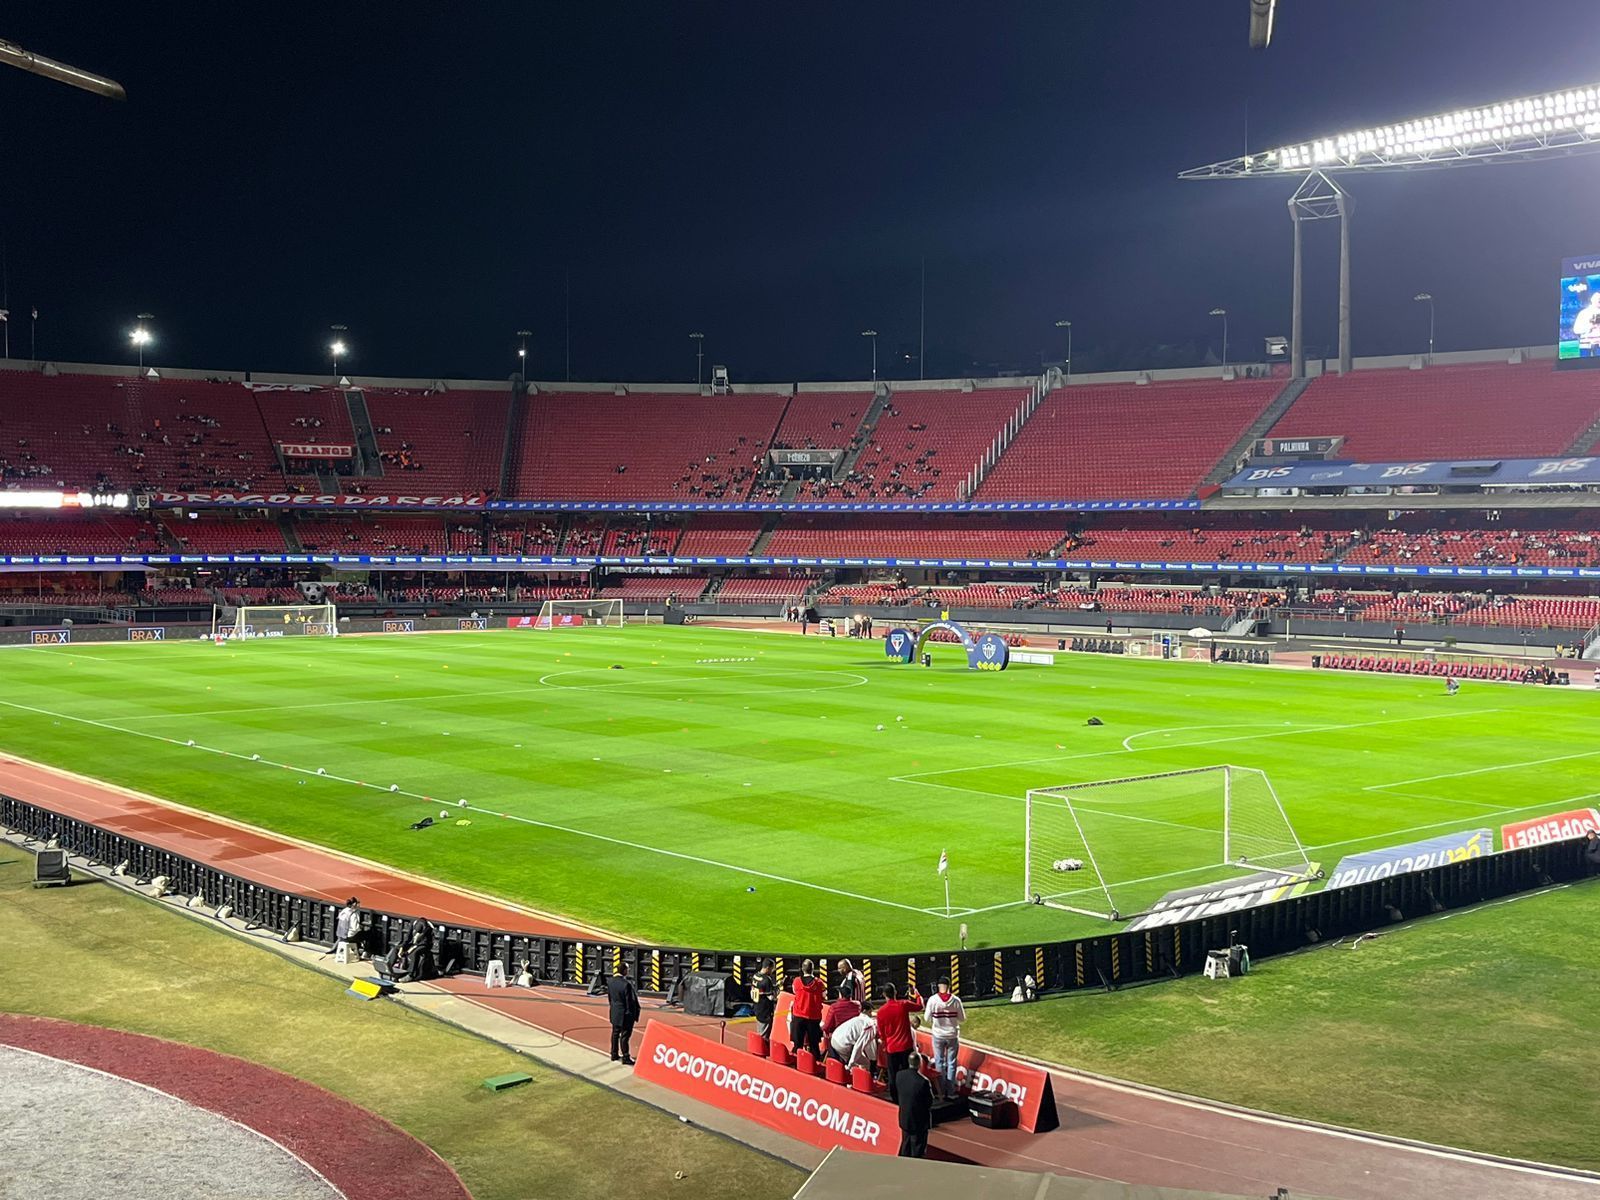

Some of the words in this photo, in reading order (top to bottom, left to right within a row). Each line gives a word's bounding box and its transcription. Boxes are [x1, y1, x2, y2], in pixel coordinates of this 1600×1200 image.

[282, 446, 350, 455] FALANGE
[1279, 442, 1309, 453] PALHINHA
[306, 625, 332, 635] BRAX
[386, 623, 411, 632] BRAX
[460, 620, 484, 630] BRAX
[35, 632, 67, 643] BRAX
[131, 629, 161, 640] BRAX
[652, 1043, 881, 1146] SOCIOTORCEDOR.COM.BR
